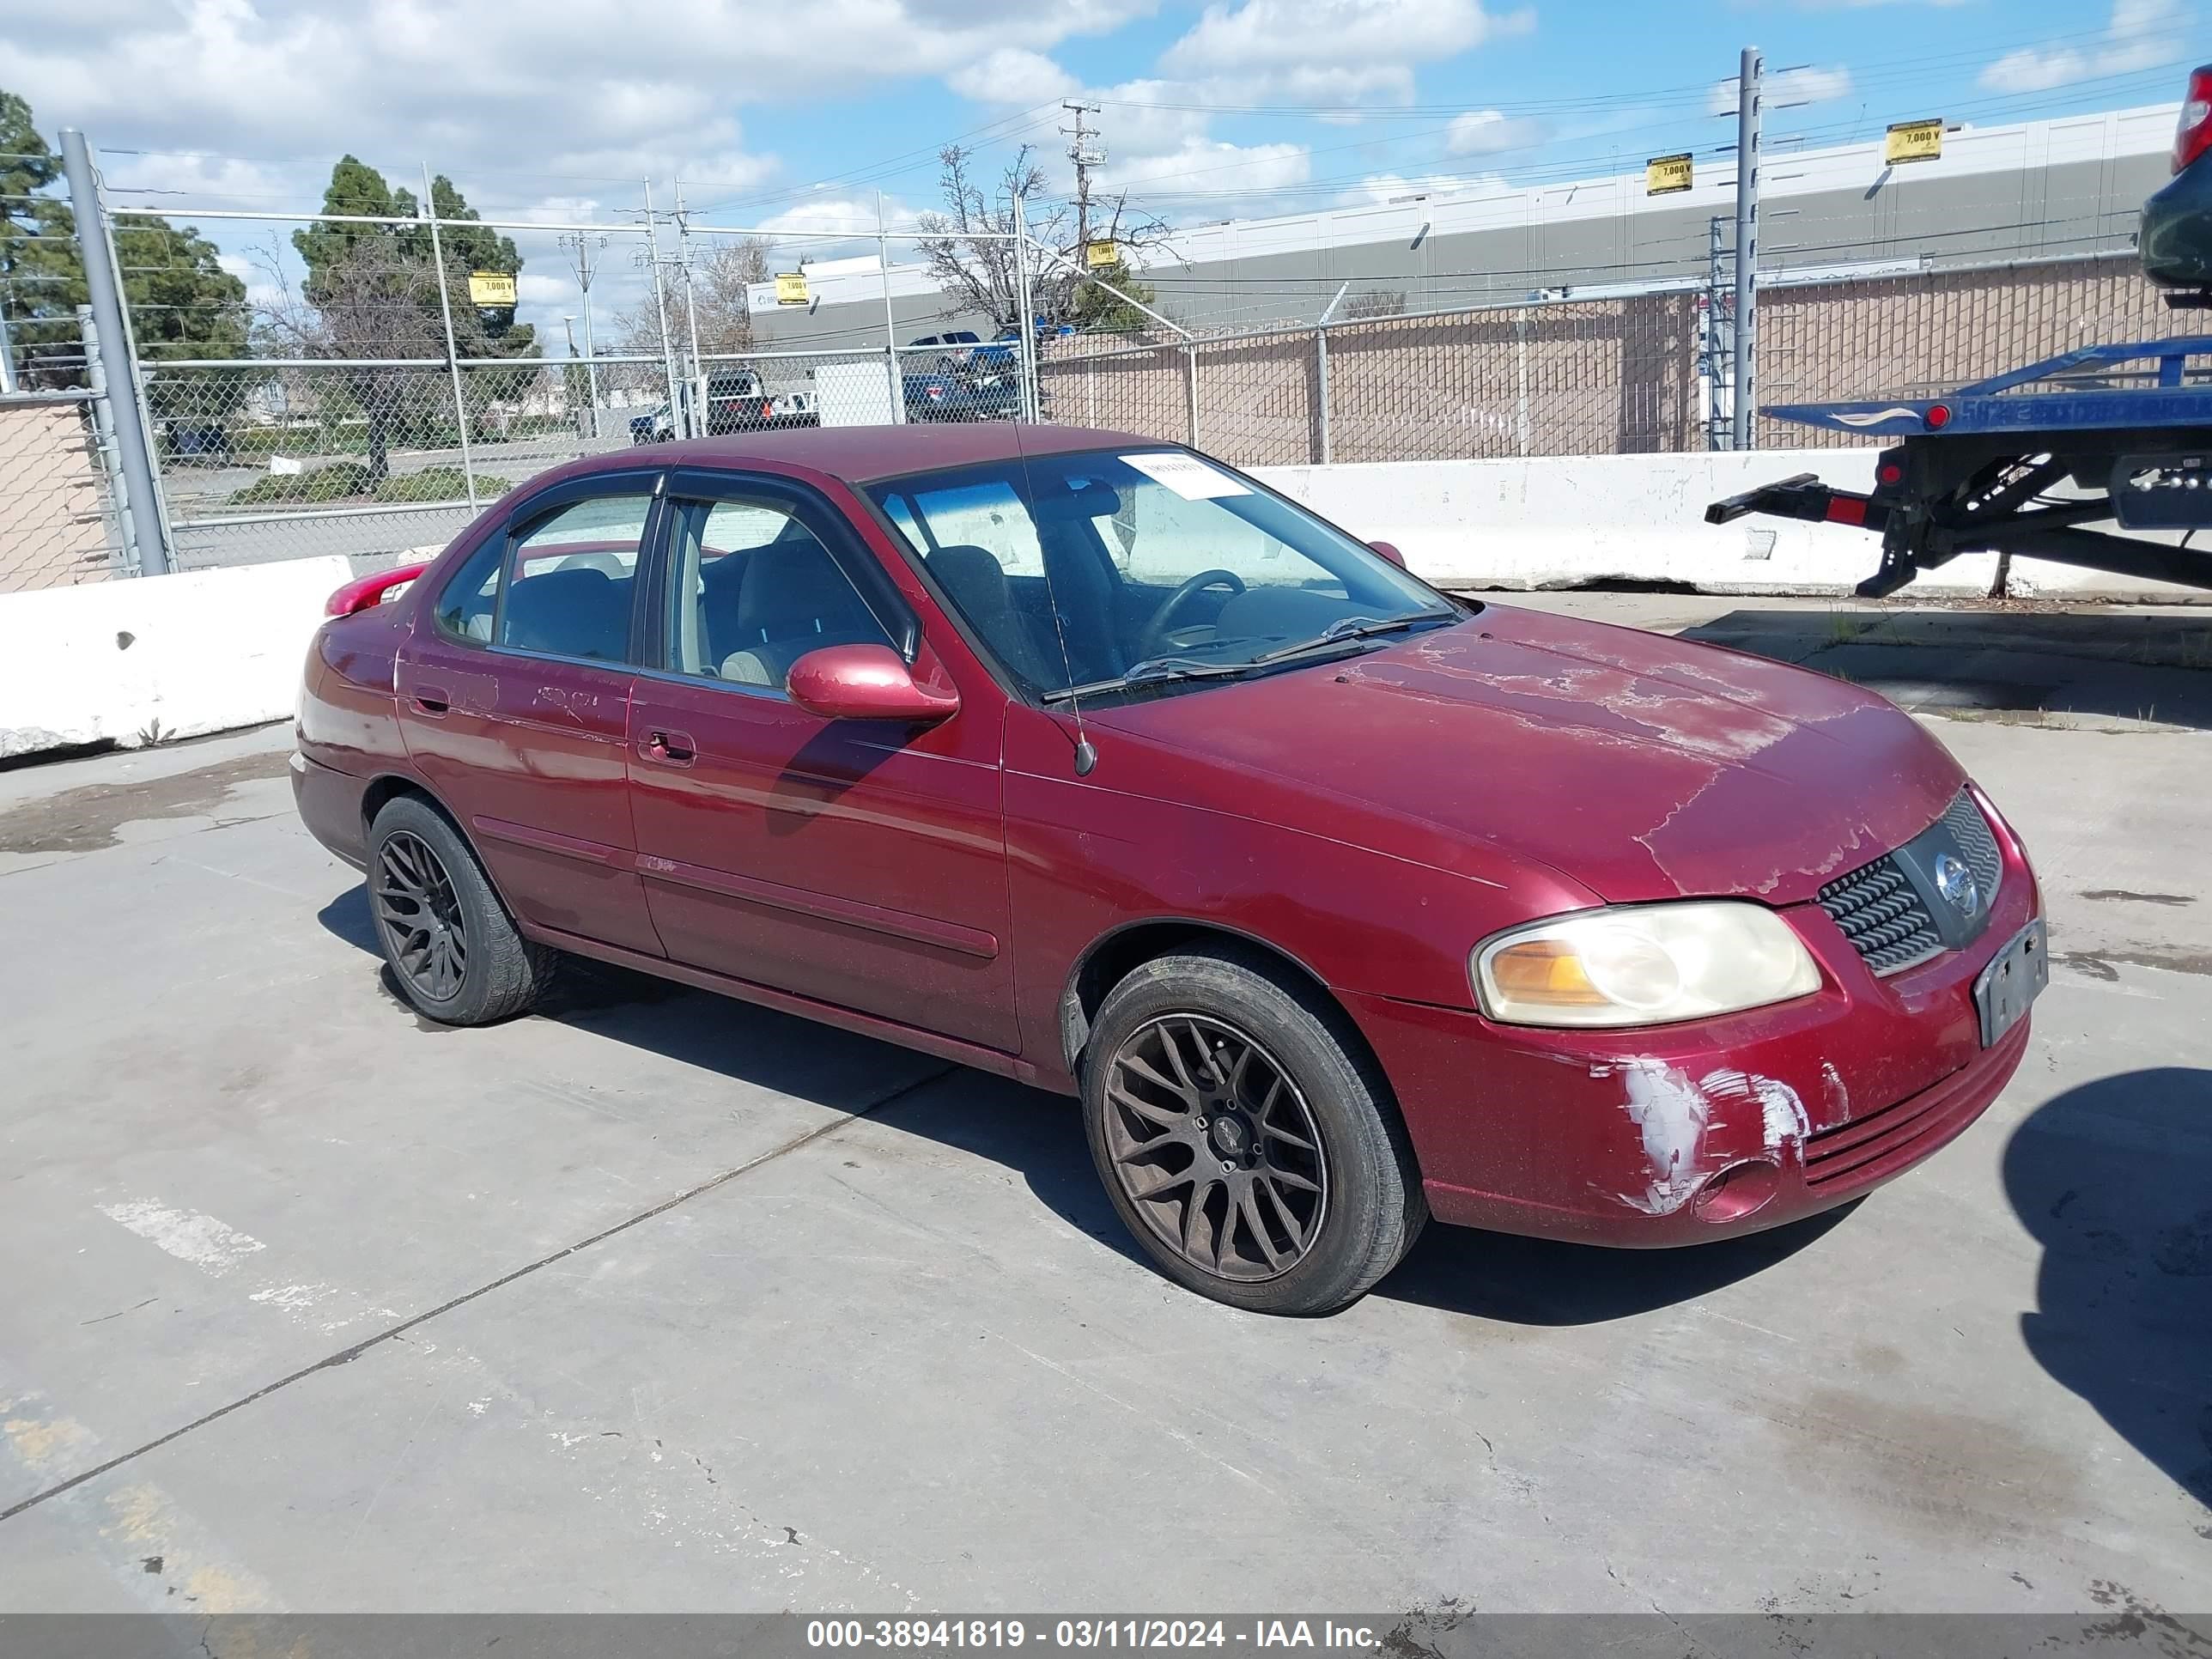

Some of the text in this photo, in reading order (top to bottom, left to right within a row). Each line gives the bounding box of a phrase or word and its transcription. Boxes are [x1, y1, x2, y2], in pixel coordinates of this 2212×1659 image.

[1906, 130, 1940, 144] 7,000 V
[1663, 163, 1691, 177] 7,000 V
[485, 282, 512, 292] 7,000 V
